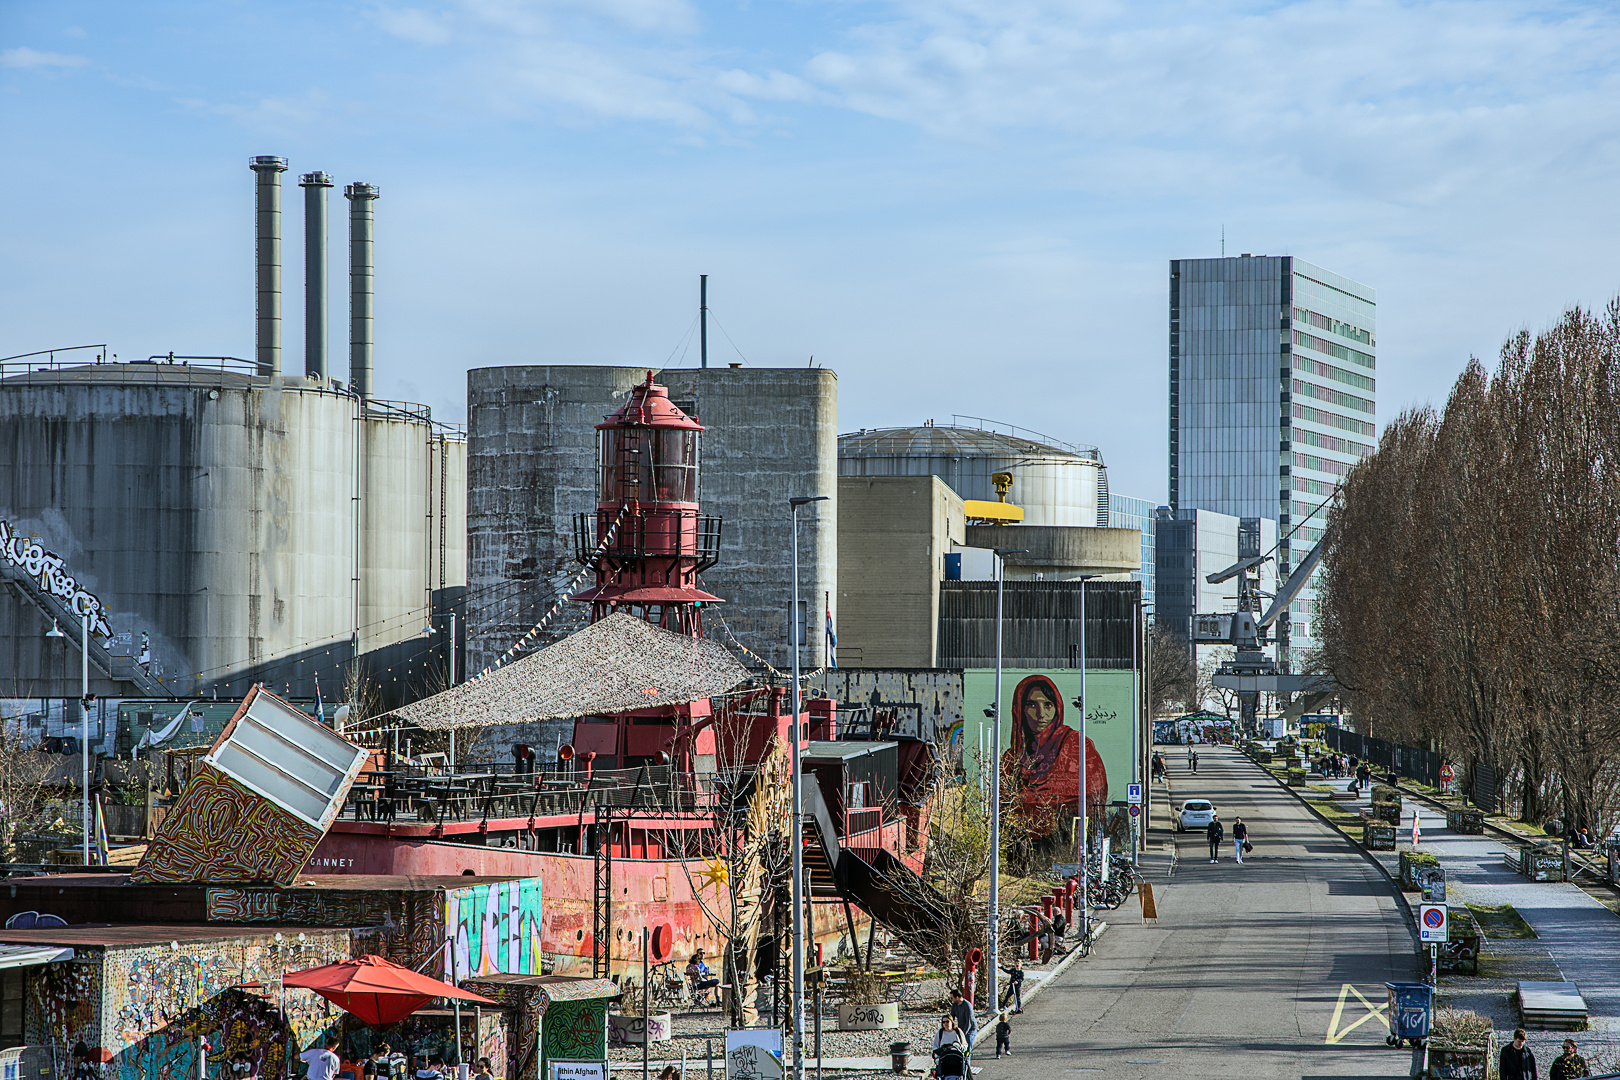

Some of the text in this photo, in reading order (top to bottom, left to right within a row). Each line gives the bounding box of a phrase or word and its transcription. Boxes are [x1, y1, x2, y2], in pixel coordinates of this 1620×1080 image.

[310, 857, 354, 867] GANNET
[1402, 1011, 1426, 1035] 161
[575, 1067, 598, 1077] Afghan
